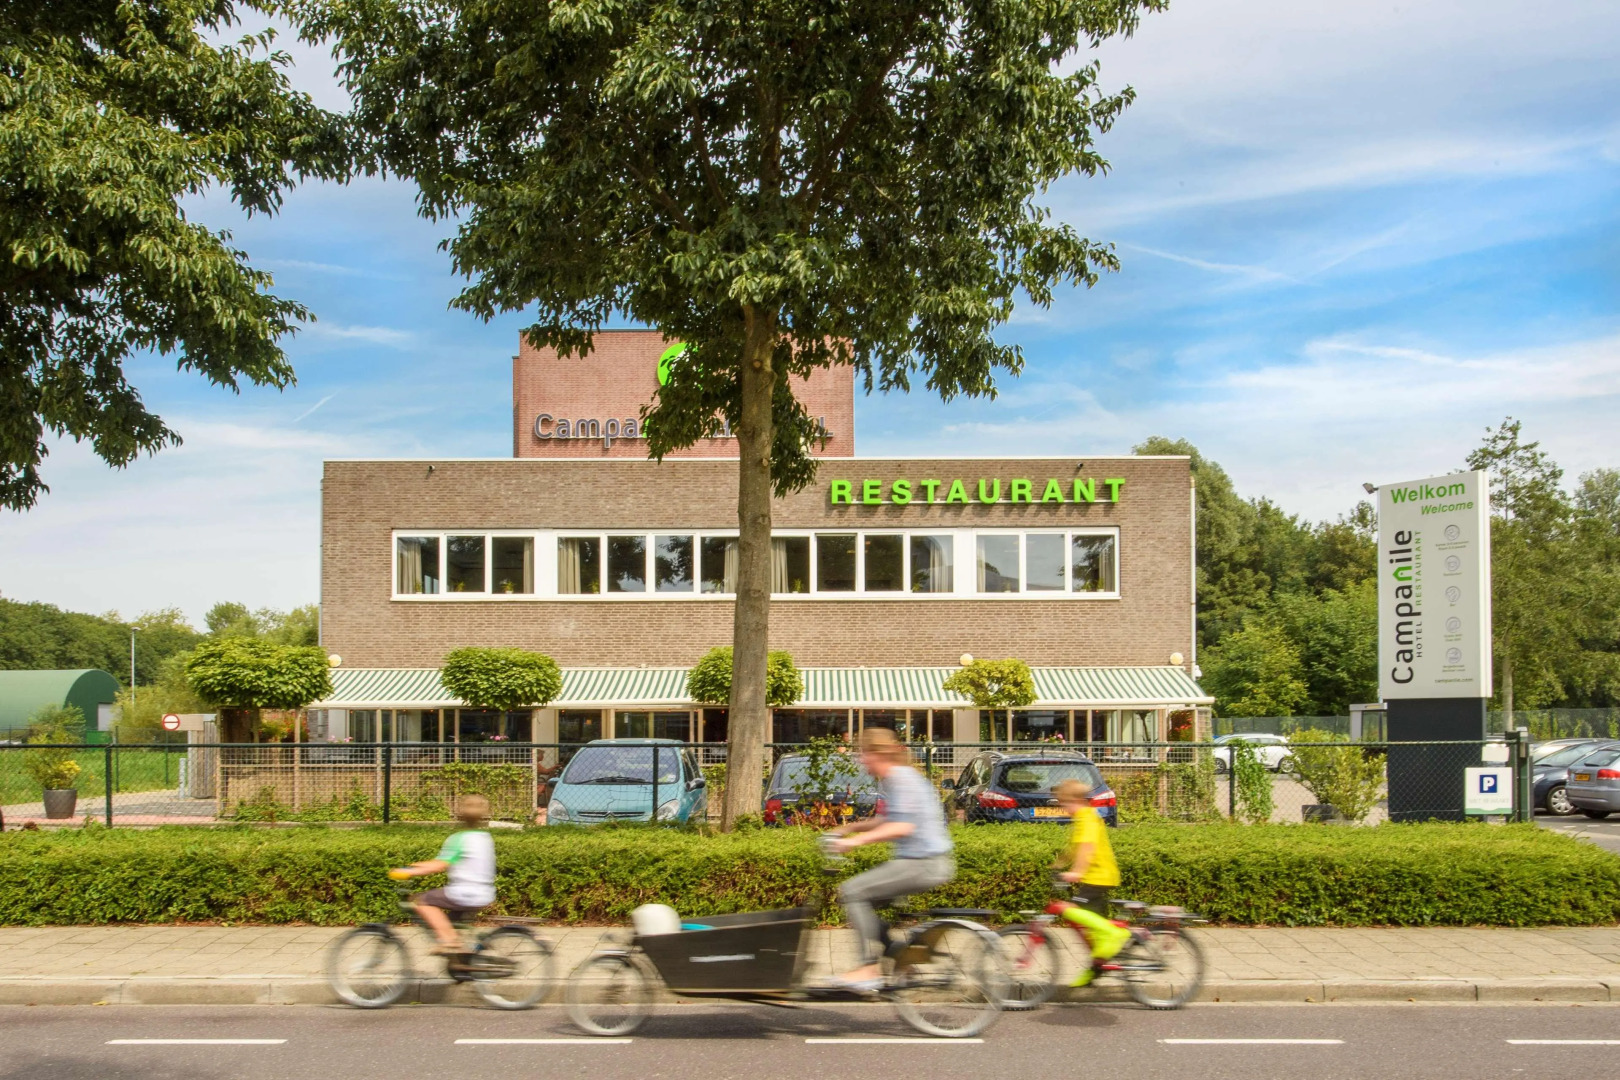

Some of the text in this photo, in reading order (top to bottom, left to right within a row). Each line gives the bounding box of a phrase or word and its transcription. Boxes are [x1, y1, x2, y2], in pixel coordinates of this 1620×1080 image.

[533, 413, 652, 448] Campa
[831, 477, 1126, 505] RESTAURANT
[1390, 482, 1466, 504] Welkom
[1420, 500, 1475, 515] Welcome
[1414, 530, 1423, 607] RESTAURANT
[1389, 530, 1422, 684] Campanile
[1482, 776, 1495, 791] P
